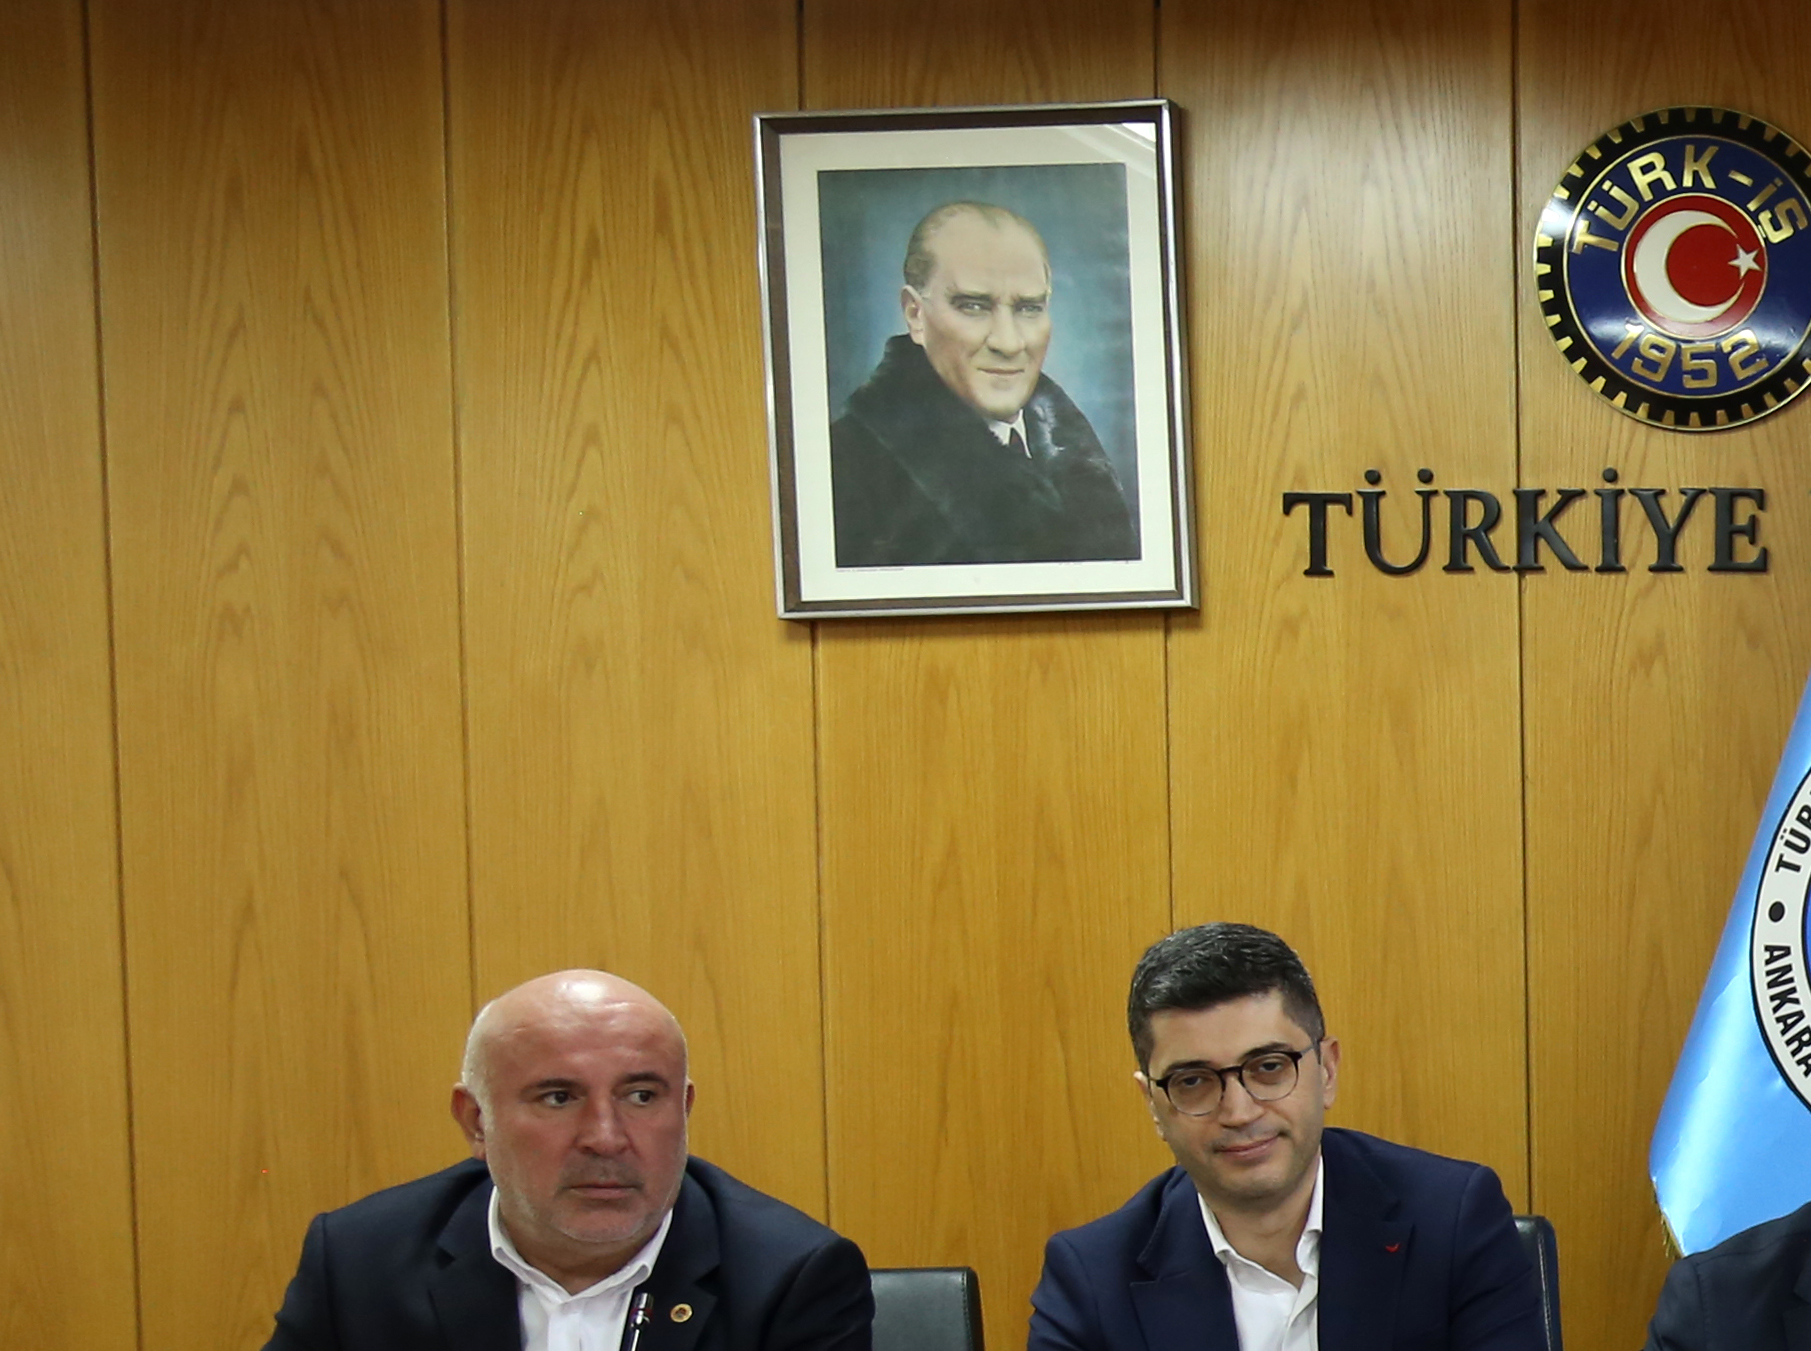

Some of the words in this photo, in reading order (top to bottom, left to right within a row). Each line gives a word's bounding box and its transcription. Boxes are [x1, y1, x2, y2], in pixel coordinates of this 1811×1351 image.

[1571, 144, 1808, 255] TÜRK-İŞ
[1610, 318, 1770, 390] 1952
[1282, 467, 1770, 576] TÜRKİYE
